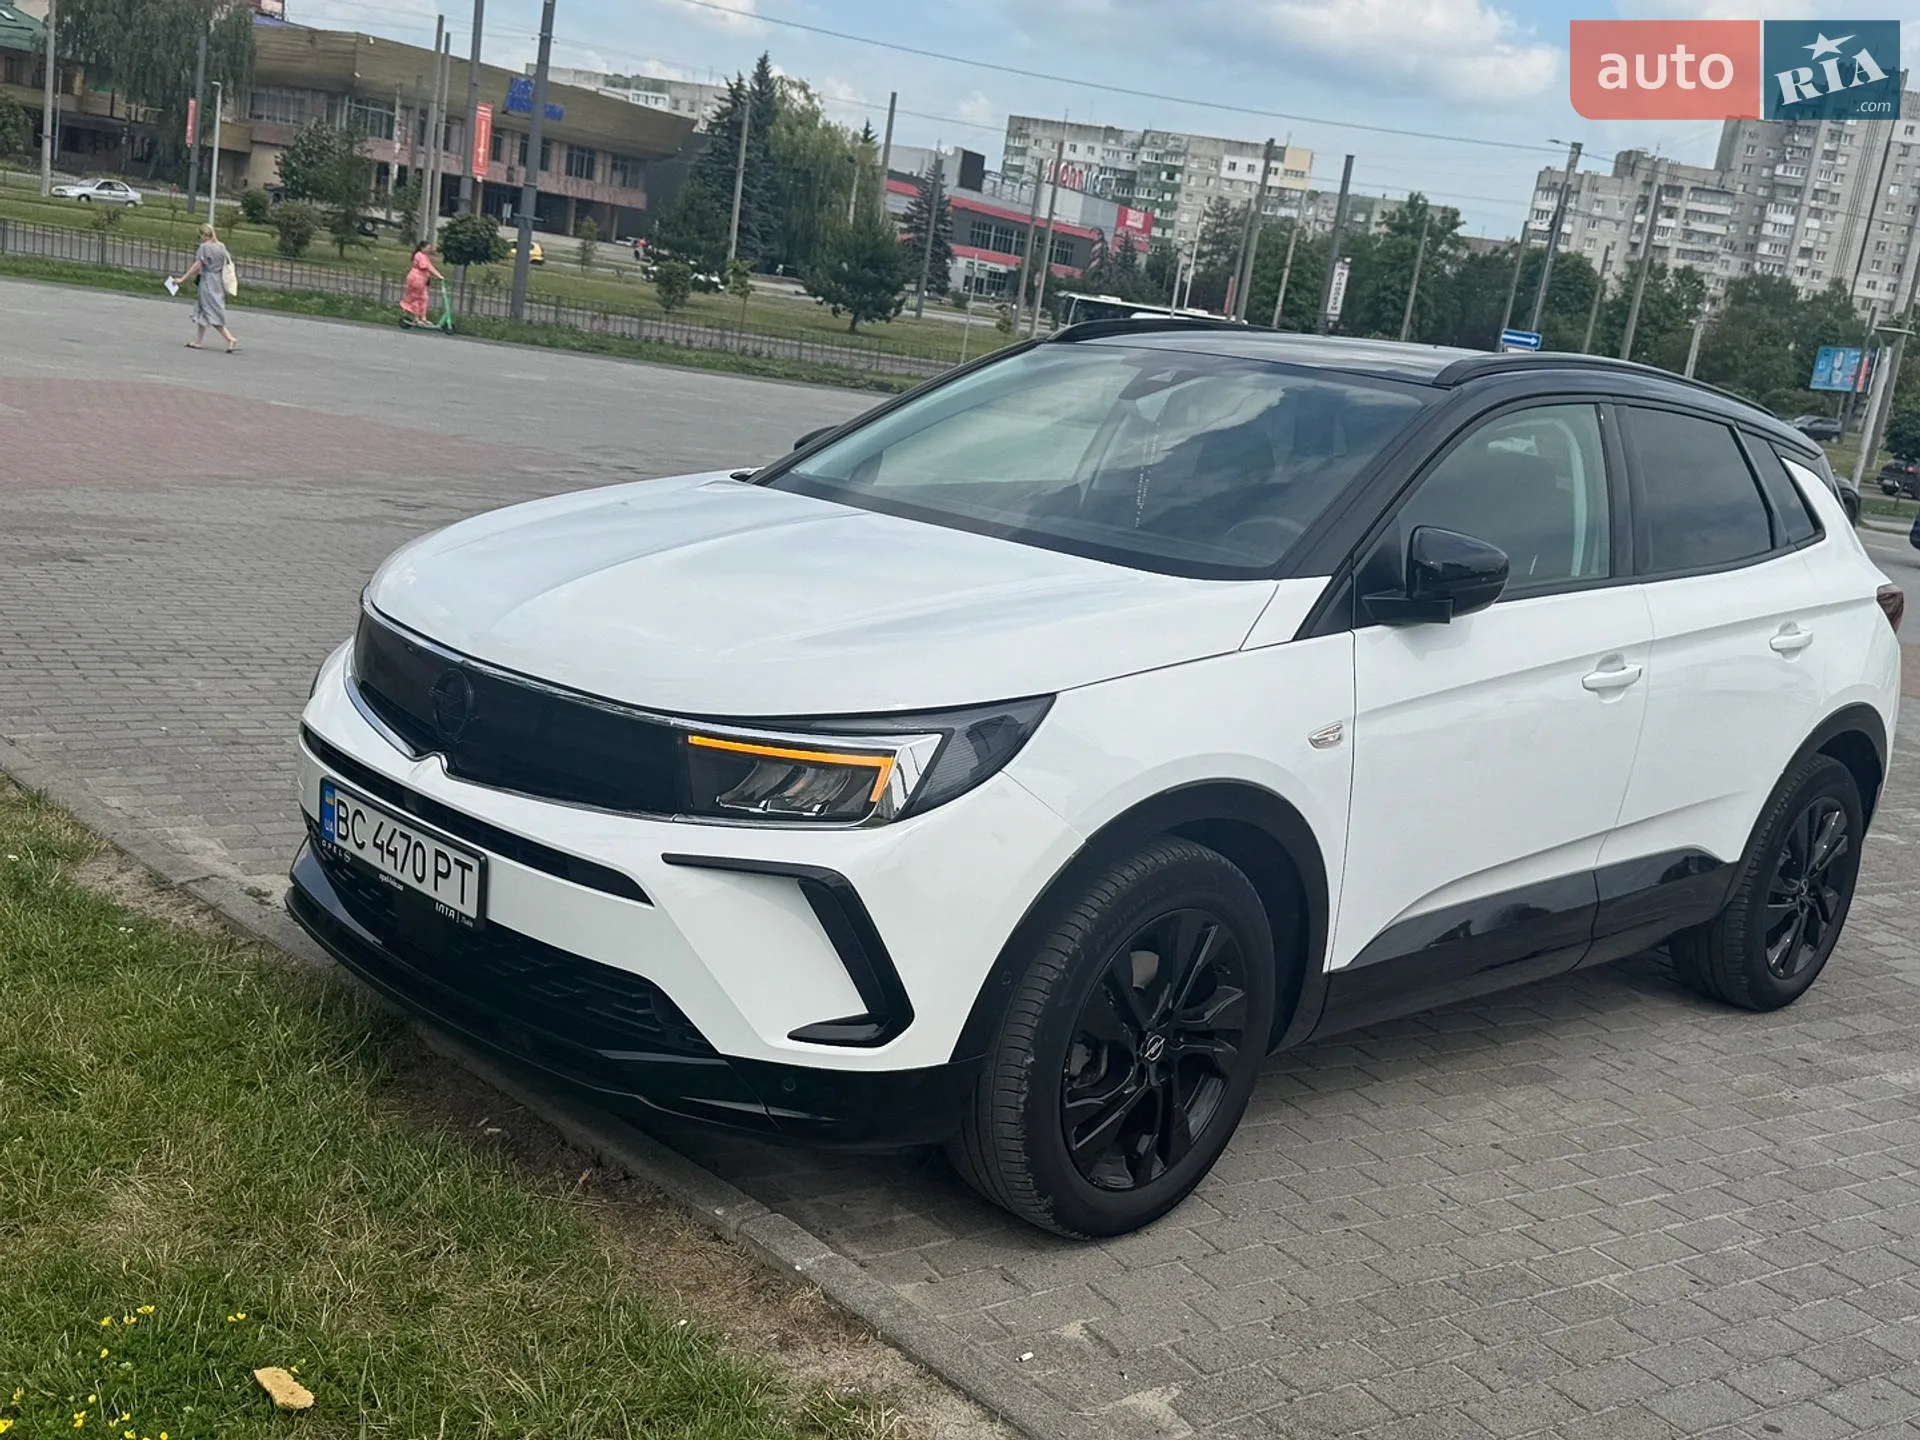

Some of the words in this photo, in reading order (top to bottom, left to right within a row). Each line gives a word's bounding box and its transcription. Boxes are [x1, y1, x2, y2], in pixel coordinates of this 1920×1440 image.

[337, 798, 366, 850] BC
[373, 821, 426, 884] 4470
[434, 848, 473, 906] PT
